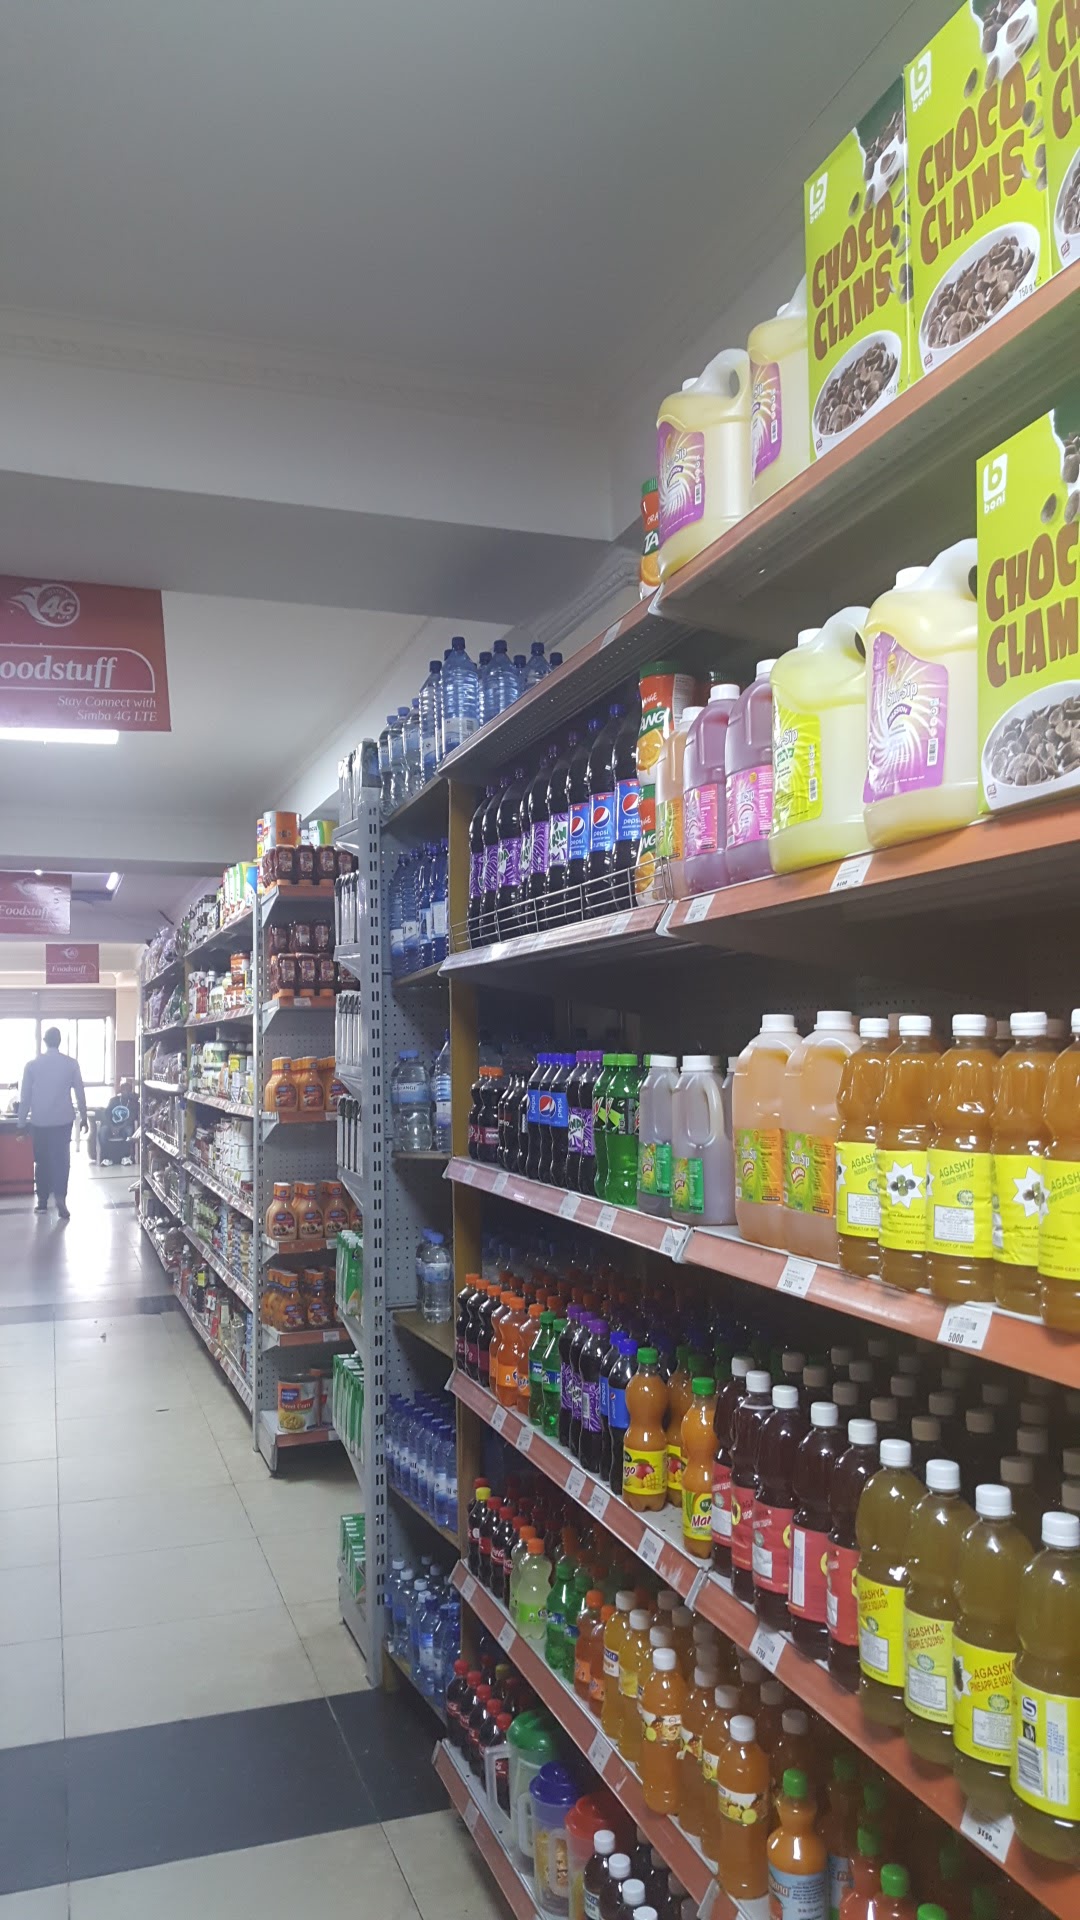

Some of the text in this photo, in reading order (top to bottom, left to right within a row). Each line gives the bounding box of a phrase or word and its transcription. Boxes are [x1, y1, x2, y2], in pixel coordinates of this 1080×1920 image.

[912, 86, 932, 113] boni
[917, 61, 1026, 207] CHOCO
[920, 129, 1025, 266] CLAMS
[812, 190, 894, 309] CHOCO
[1018, 286, 1029, 299] 750
[813, 248, 893, 361] CLAMS
[983, 490, 1006, 515] boni
[646, 512, 660, 525] ORA
[644, 531, 660, 554] TA
[986, 520, 1080, 622] CHOC
[40, 594, 76, 617] 4G
[987, 597, 1080, 688] CLAM
[0, 655, 118, 688] oodstuff
[57, 696, 156, 709] Stay Connect with
[76, 710, 158, 722] Simba 4G LTE
[639, 710, 665, 732] ANG
[641, 833, 656, 848] NG
[851, 1152, 875, 1169] AGASH
[1050, 1171, 1080, 1191] AGASH
[948, 1332, 964, 1344] 5000
[974, 1661, 1012, 1680] AGASHY
[970, 1677, 999, 1692] PINEAPPLE
